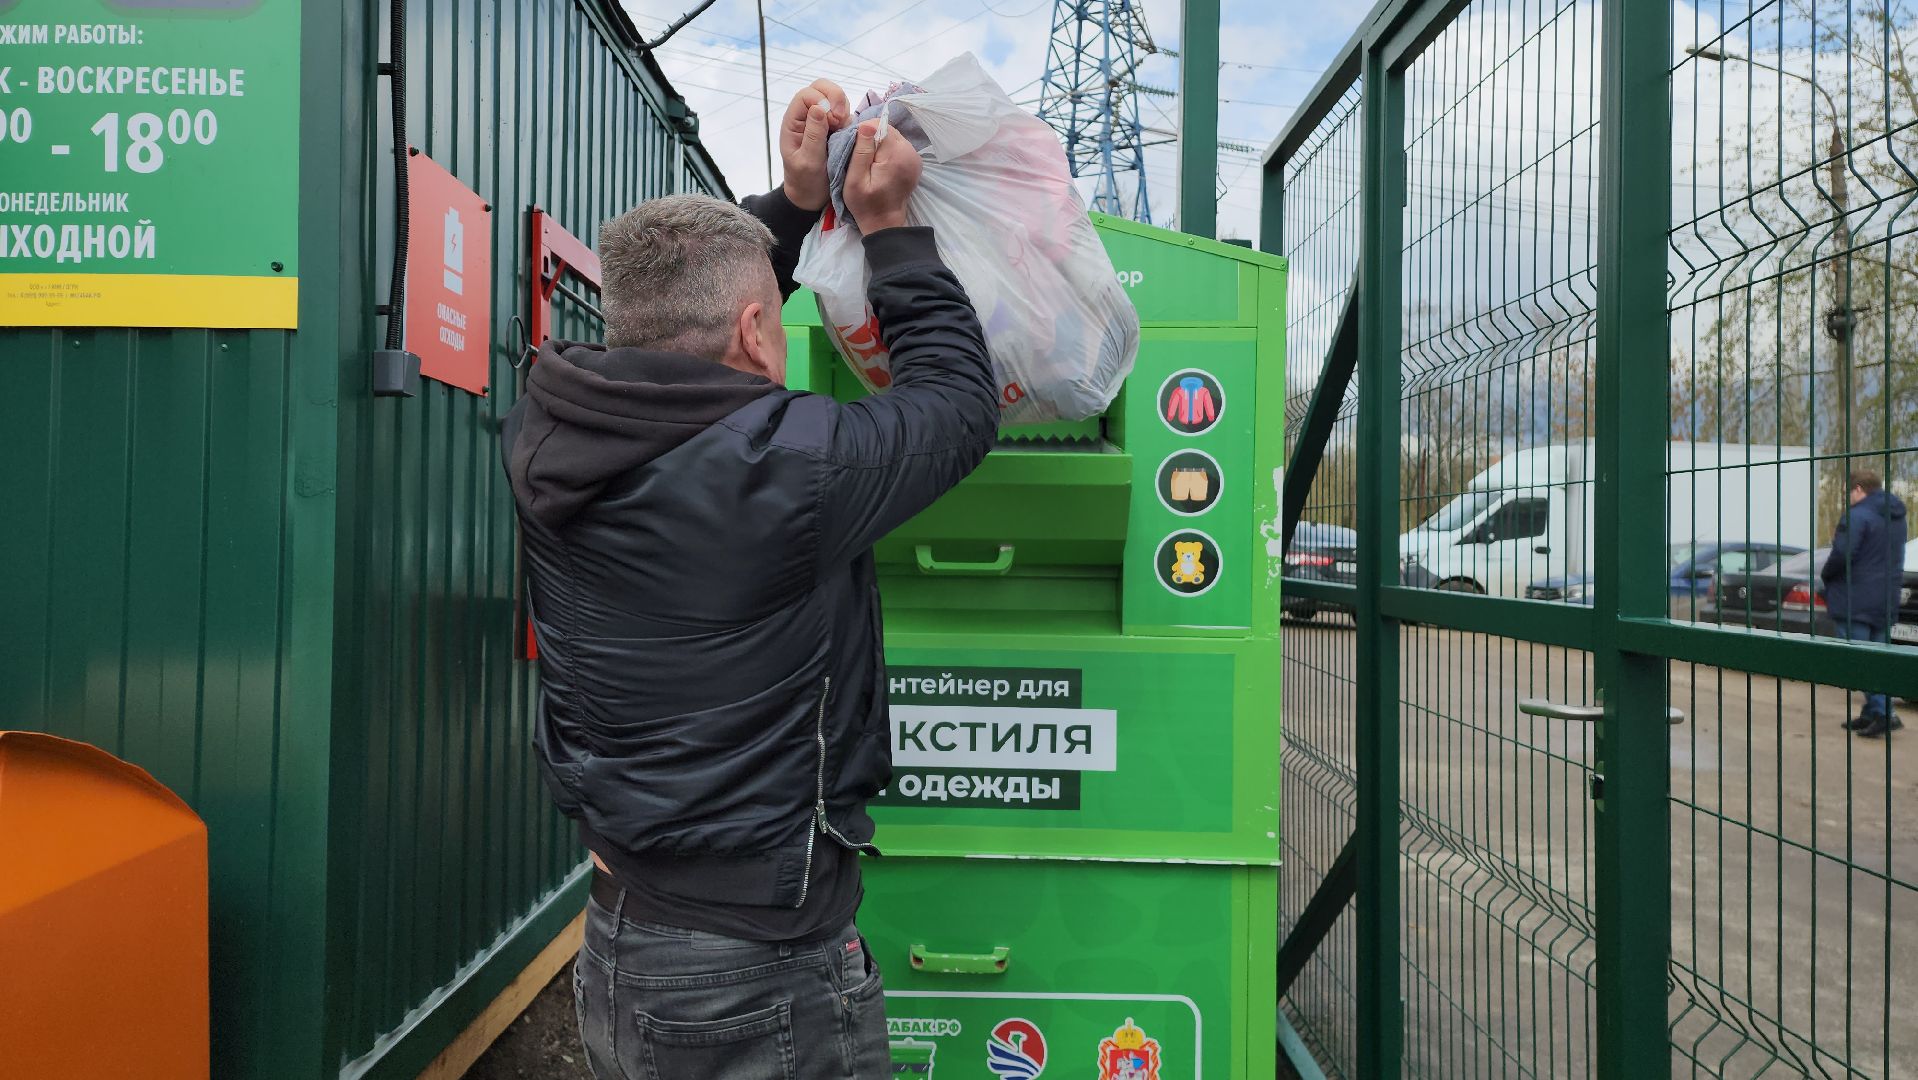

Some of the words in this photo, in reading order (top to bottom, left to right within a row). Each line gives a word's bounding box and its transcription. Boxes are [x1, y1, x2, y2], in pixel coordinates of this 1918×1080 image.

[54, 24, 144, 45] РАБОТЫ:
[37, 66, 245, 97] ВОСКРЕСЕНЬЕ
[0, 192, 129, 216] ОНЕДЕЛЬНИК
[437, 302, 466, 330] ОПАСНЫЕ
[439, 326, 464, 351] ОТХОДЫ
[889, 672, 1010, 701] нтейнер
[1016, 679, 1069, 698] для
[898, 720, 1093, 755] КСТИЛЯ
[898, 774, 1060, 802] одежды
[886, 1019, 961, 1036] АБАК.РФ
